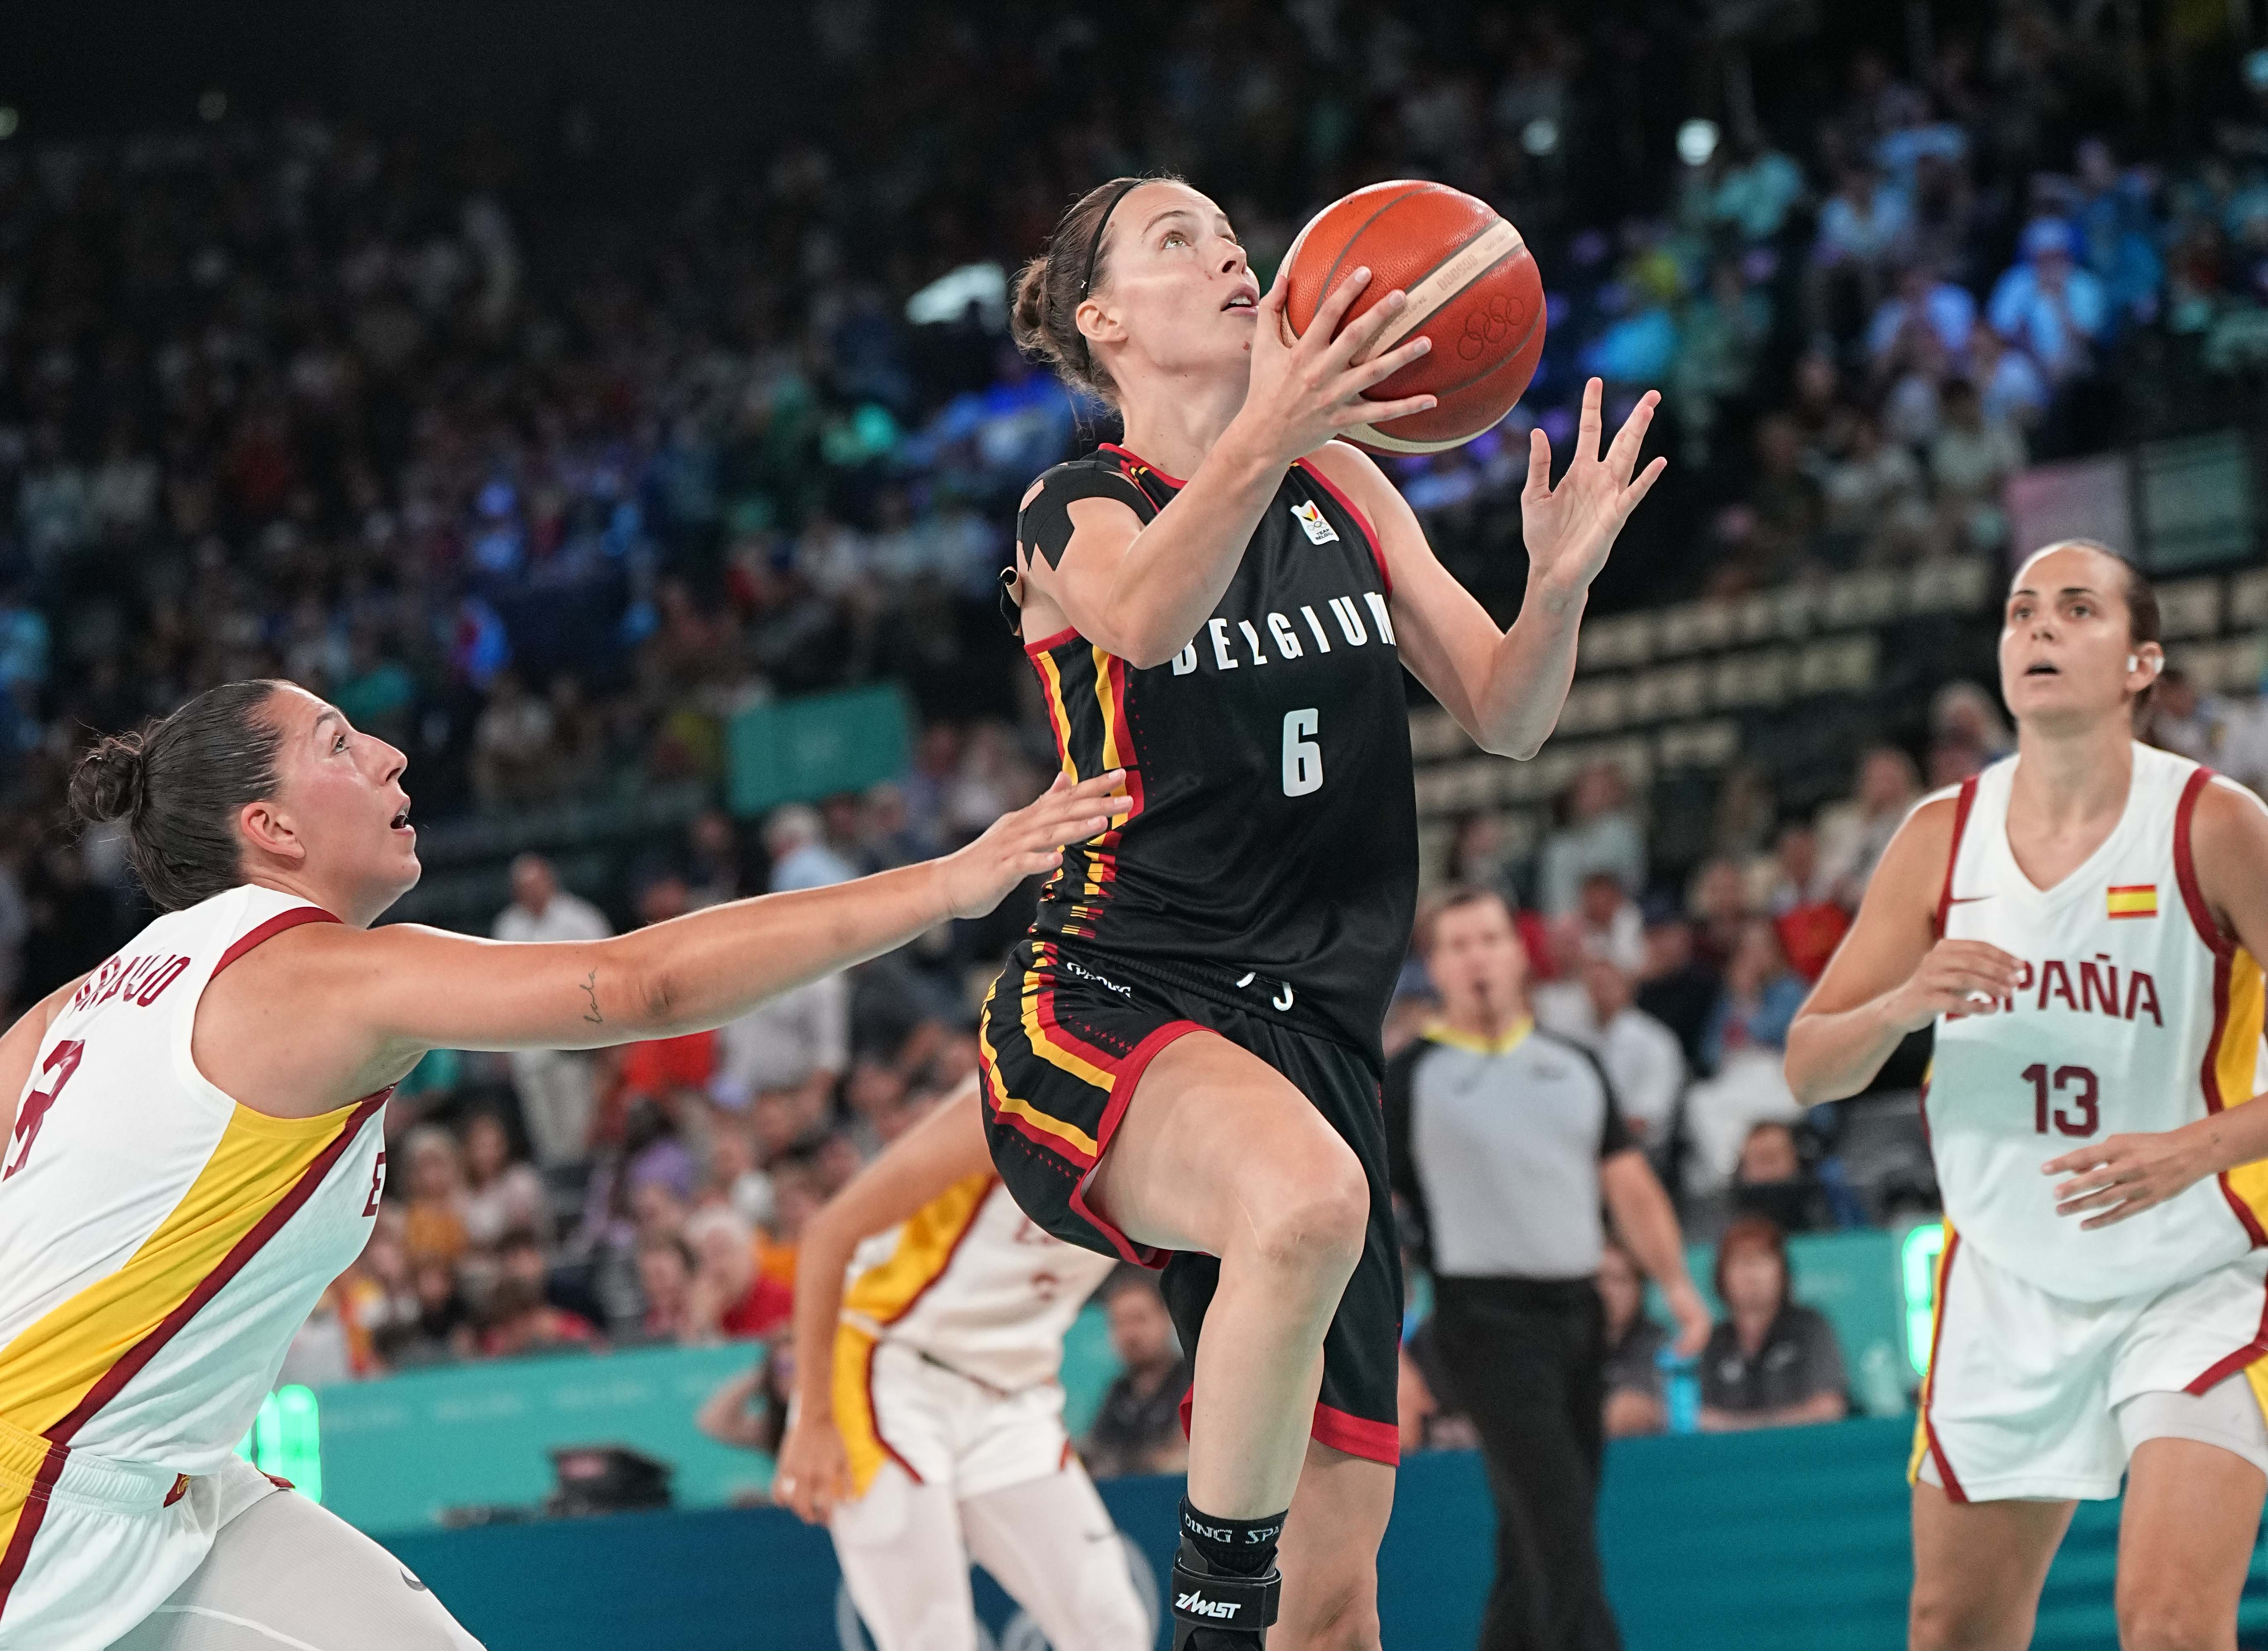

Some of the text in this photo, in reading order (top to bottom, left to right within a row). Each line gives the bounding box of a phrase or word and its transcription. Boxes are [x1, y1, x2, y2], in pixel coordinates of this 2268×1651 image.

[1283, 708, 1323, 797] 6
[1945, 953, 2163, 1027] PAÑA
[2020, 1063, 2099, 1138] 13
[1175, 1590, 1242, 1619] ZAMST
